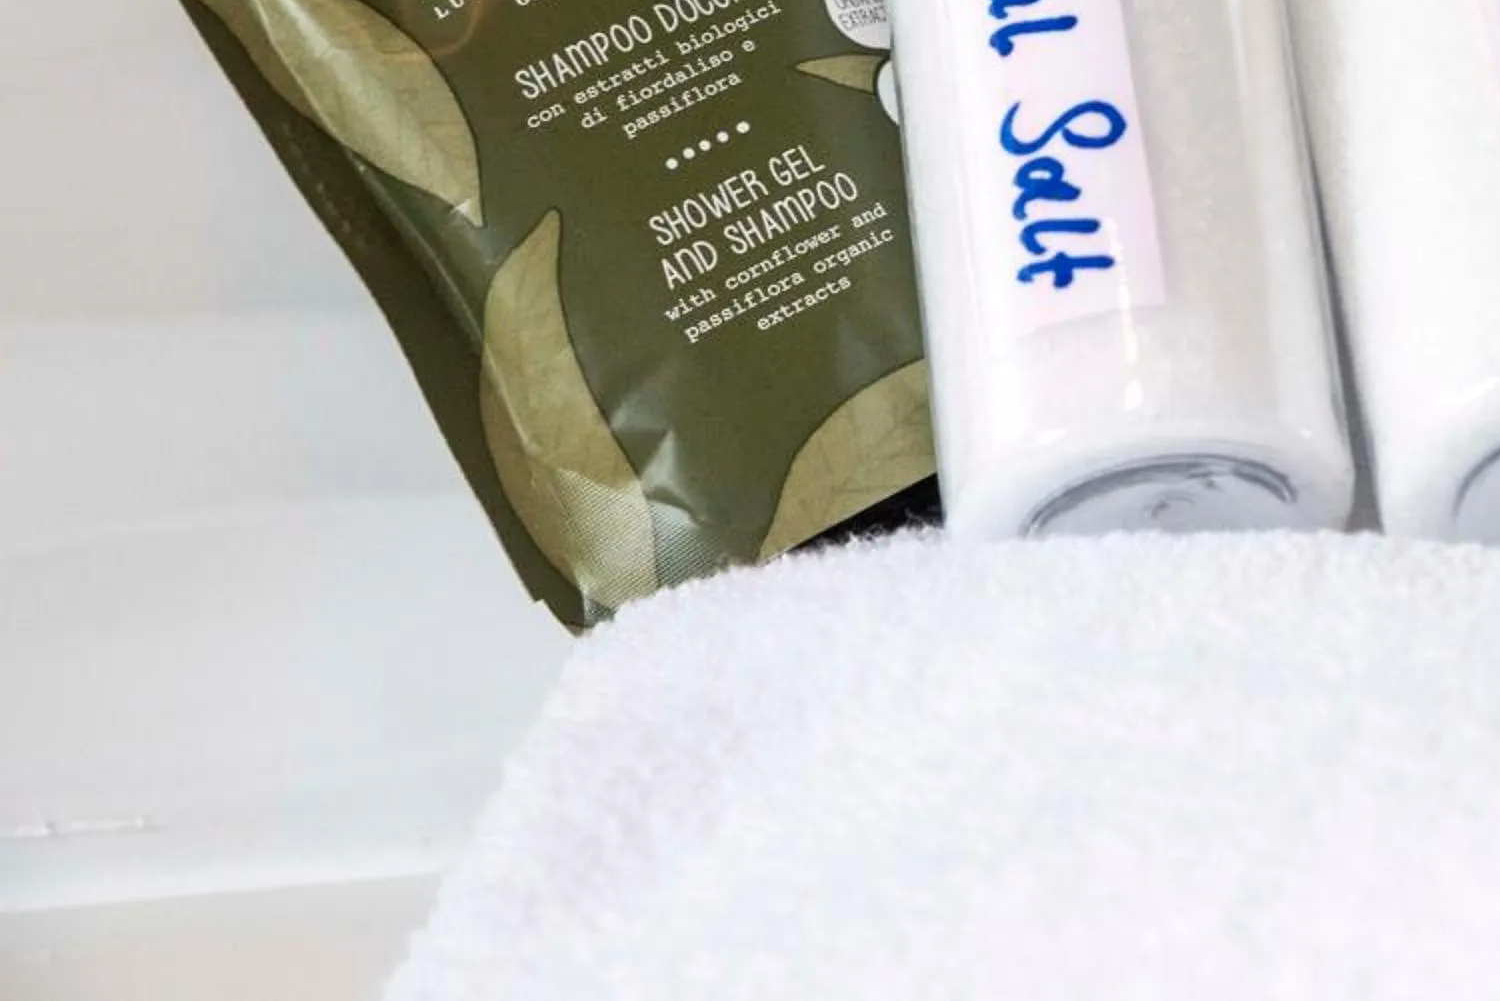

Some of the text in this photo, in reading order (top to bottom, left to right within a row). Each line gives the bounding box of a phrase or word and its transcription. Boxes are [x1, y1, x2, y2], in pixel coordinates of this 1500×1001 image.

[515, 15, 652, 100] SHAMPOO
[527, 0, 782, 130] con estratti biologici
[581, 39, 756, 130] di fiordaliso e
[622, 71, 743, 140] passiflora
[649, 145, 826, 246] SHOWER GEL
[660, 172, 859, 291] AND SHAMPOO
[1000, 101, 1127, 289] Salt
[664, 202, 887, 323] with cornflower and
[684, 228, 894, 343] passiflora organic
[756, 275, 852, 331] extracts
